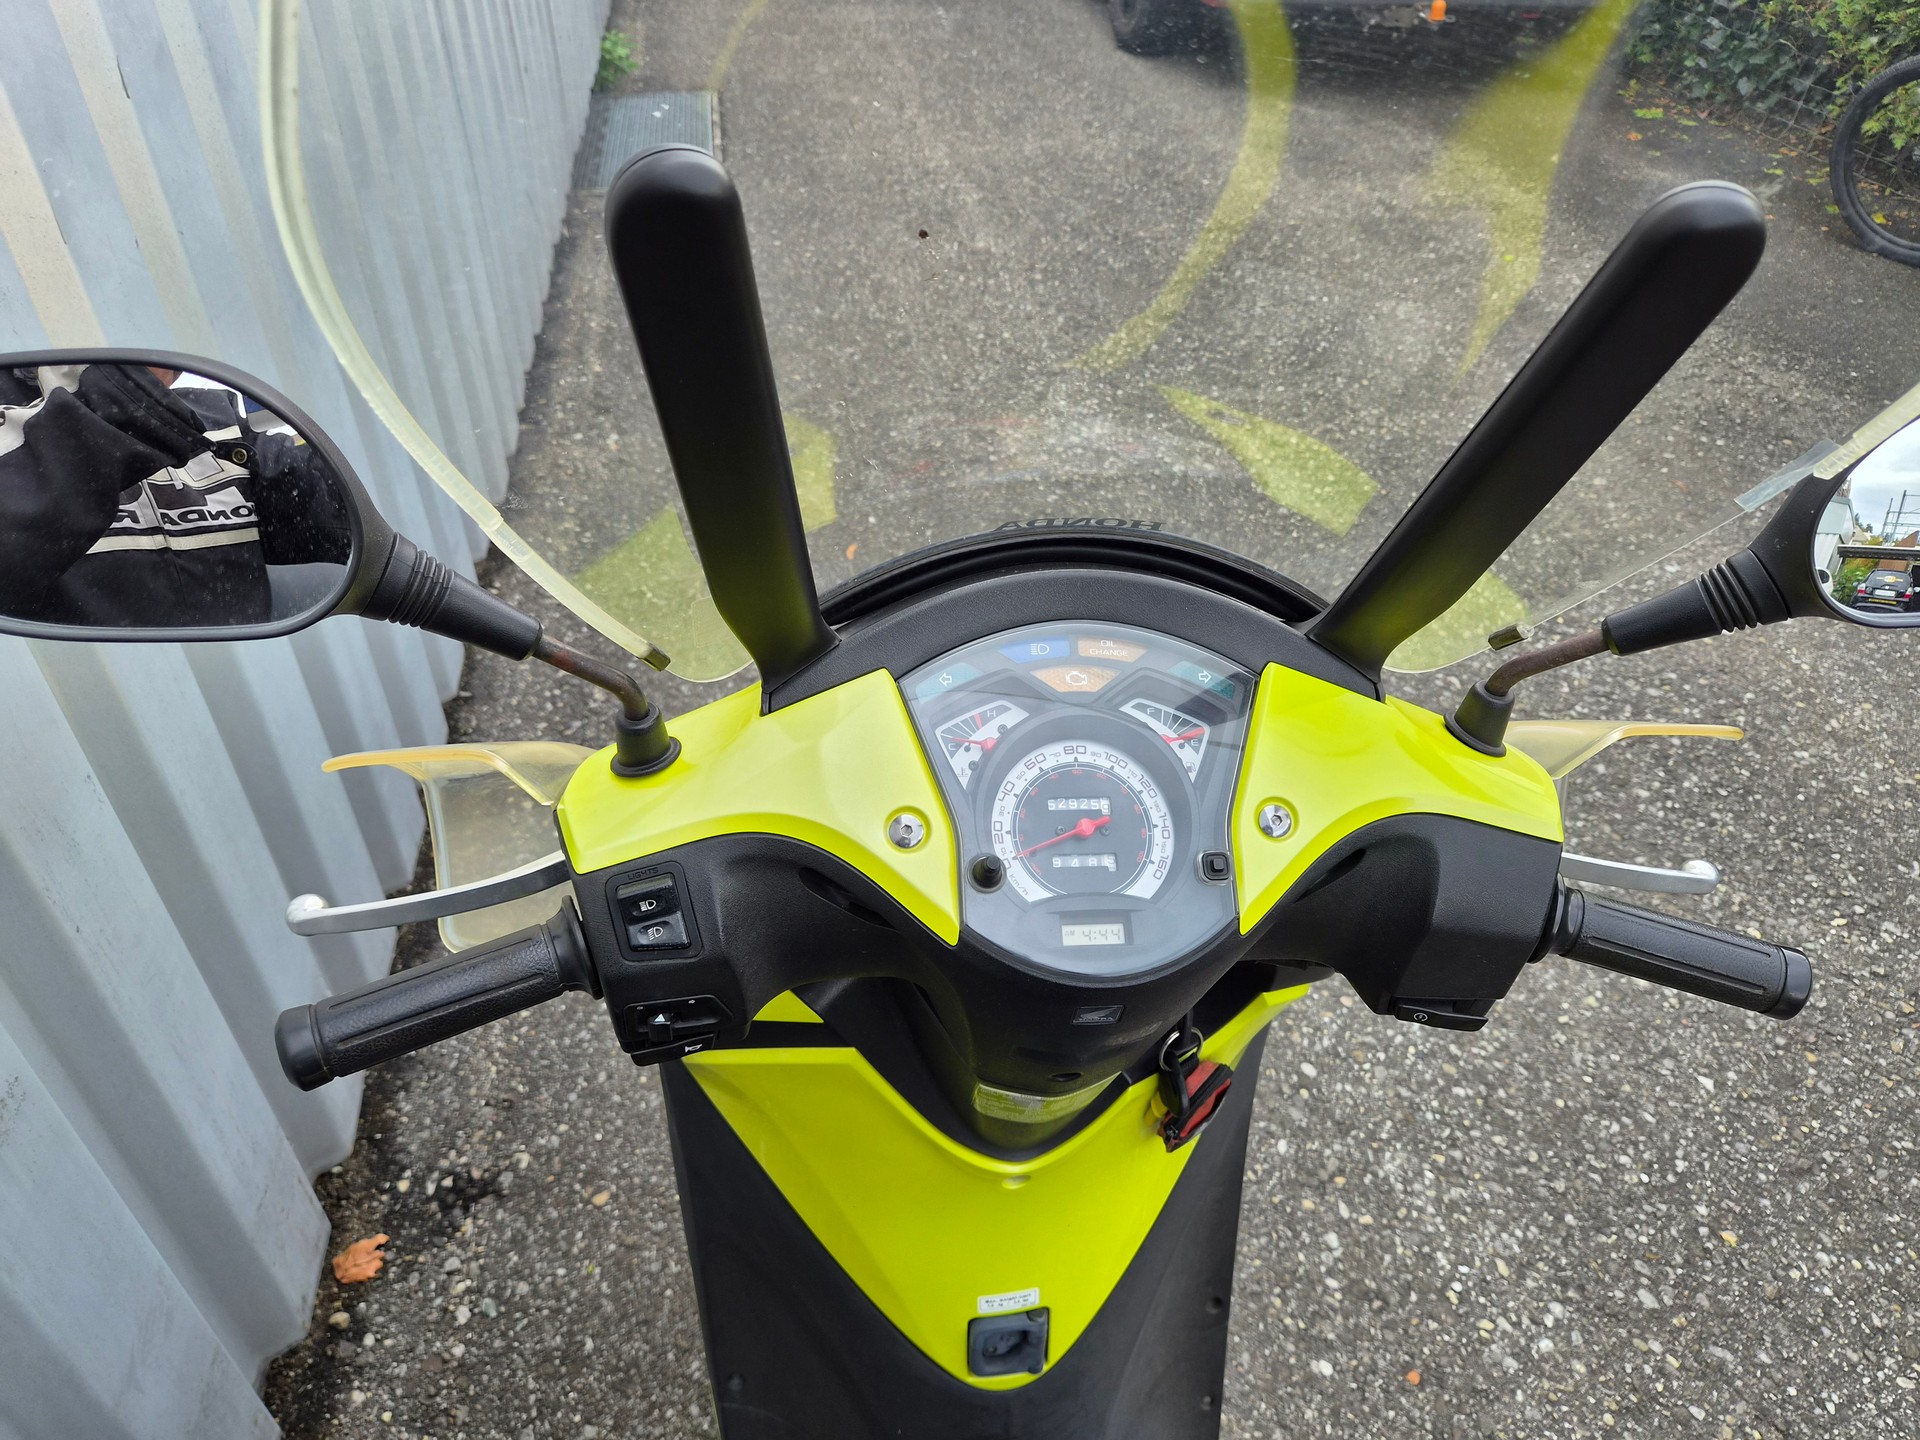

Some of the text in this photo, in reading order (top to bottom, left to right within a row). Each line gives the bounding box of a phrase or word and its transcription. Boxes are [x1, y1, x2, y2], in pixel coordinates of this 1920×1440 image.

[1100, 639, 1115, 648] OIL
[1089, 648, 1128, 657] CHANGE
[986, 709, 997, 718] H
[1146, 707, 1156, 715] F
[1063, 744, 1087, 755] 80
[1023, 752, 1047, 771] 60
[1104, 751, 1129, 770] 100
[997, 780, 1015, 802] 40
[1138, 773, 1158, 799] 120
[993, 820, 1004, 844] 20
[1158, 812, 1171, 840] 140
[627, 866, 659, 881] LIGHTS
[1152, 855, 1170, 881] 160
[1082, 927, 1121, 942] 4:44
